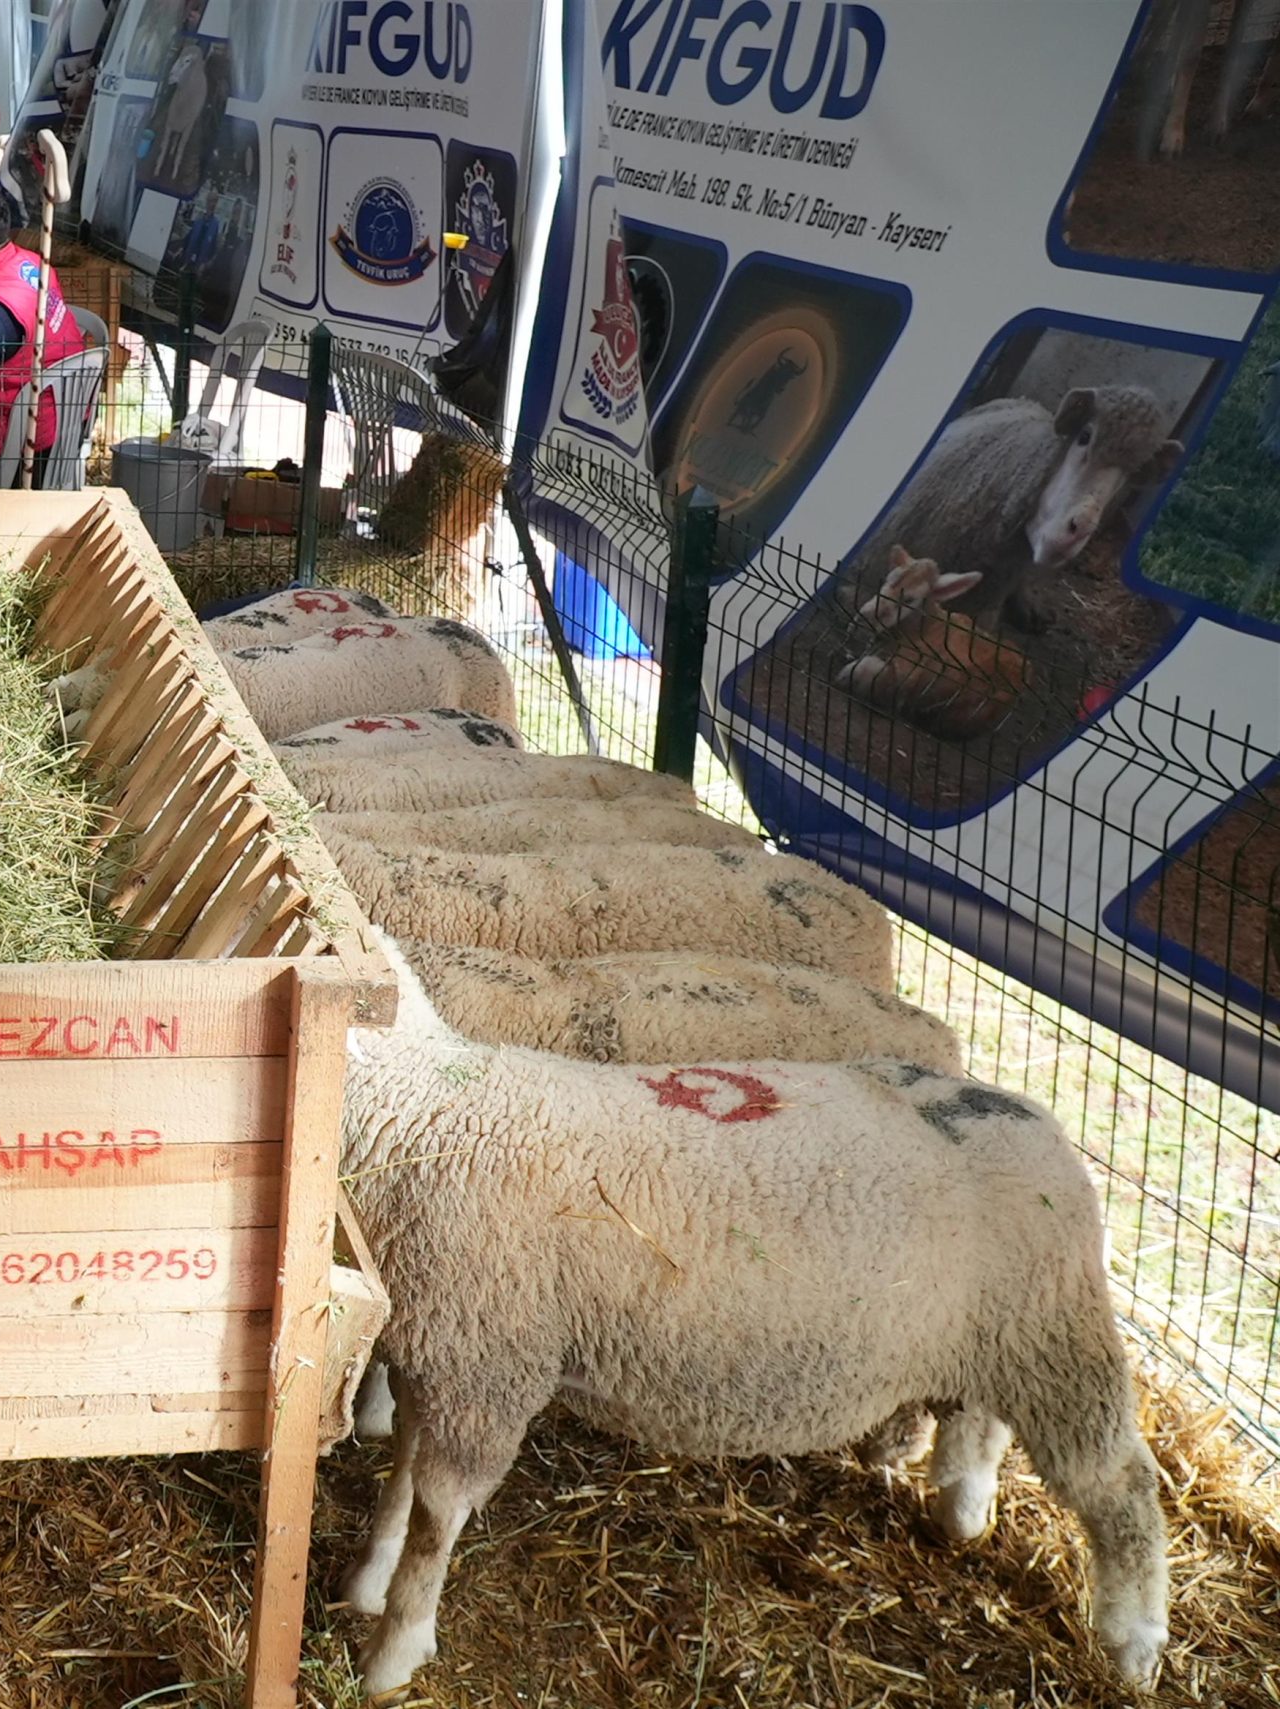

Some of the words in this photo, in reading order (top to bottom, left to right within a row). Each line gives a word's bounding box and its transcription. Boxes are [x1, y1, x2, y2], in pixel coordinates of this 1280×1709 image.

[623, 108, 642, 132] DE
[637, 109, 678, 139] FRANCE
[673, 117, 708, 146] KOYUN
[705, 120, 760, 155] GELİŞTİRME
[757, 130, 774, 156] VE
[770, 128, 810, 162] ÜRETİM
[806, 137, 859, 170] DERNEĞİ
[665, 170, 697, 201] Mah.
[700, 177, 728, 207] 198.
[731, 183, 753, 213] Sk.
[756, 188, 809, 224] No:5/1
[877, 212, 952, 253] Kayseri
